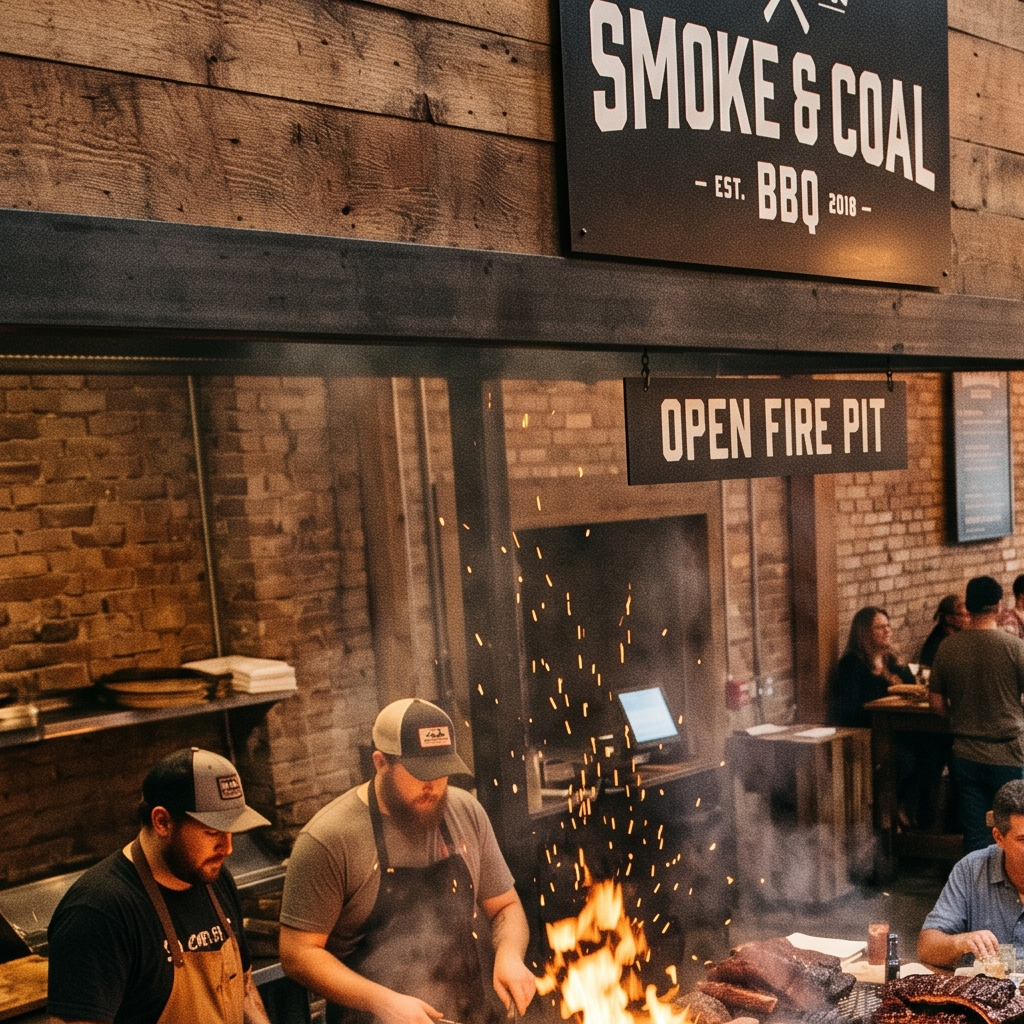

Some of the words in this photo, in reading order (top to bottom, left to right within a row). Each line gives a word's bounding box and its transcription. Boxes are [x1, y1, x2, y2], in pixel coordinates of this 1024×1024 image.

[589, 1, 780, 139] SMOKE
[792, 52, 821, 146] &
[831, 62, 935, 192] COAL
[715, 174, 746, 201] EST.
[757, 161, 819, 235] BBQ
[828, 192, 857, 217] 2018
[660, 398, 752, 462] OPEN
[765, 398, 832, 457] FIRE
[843, 398, 886, 455] PIT
